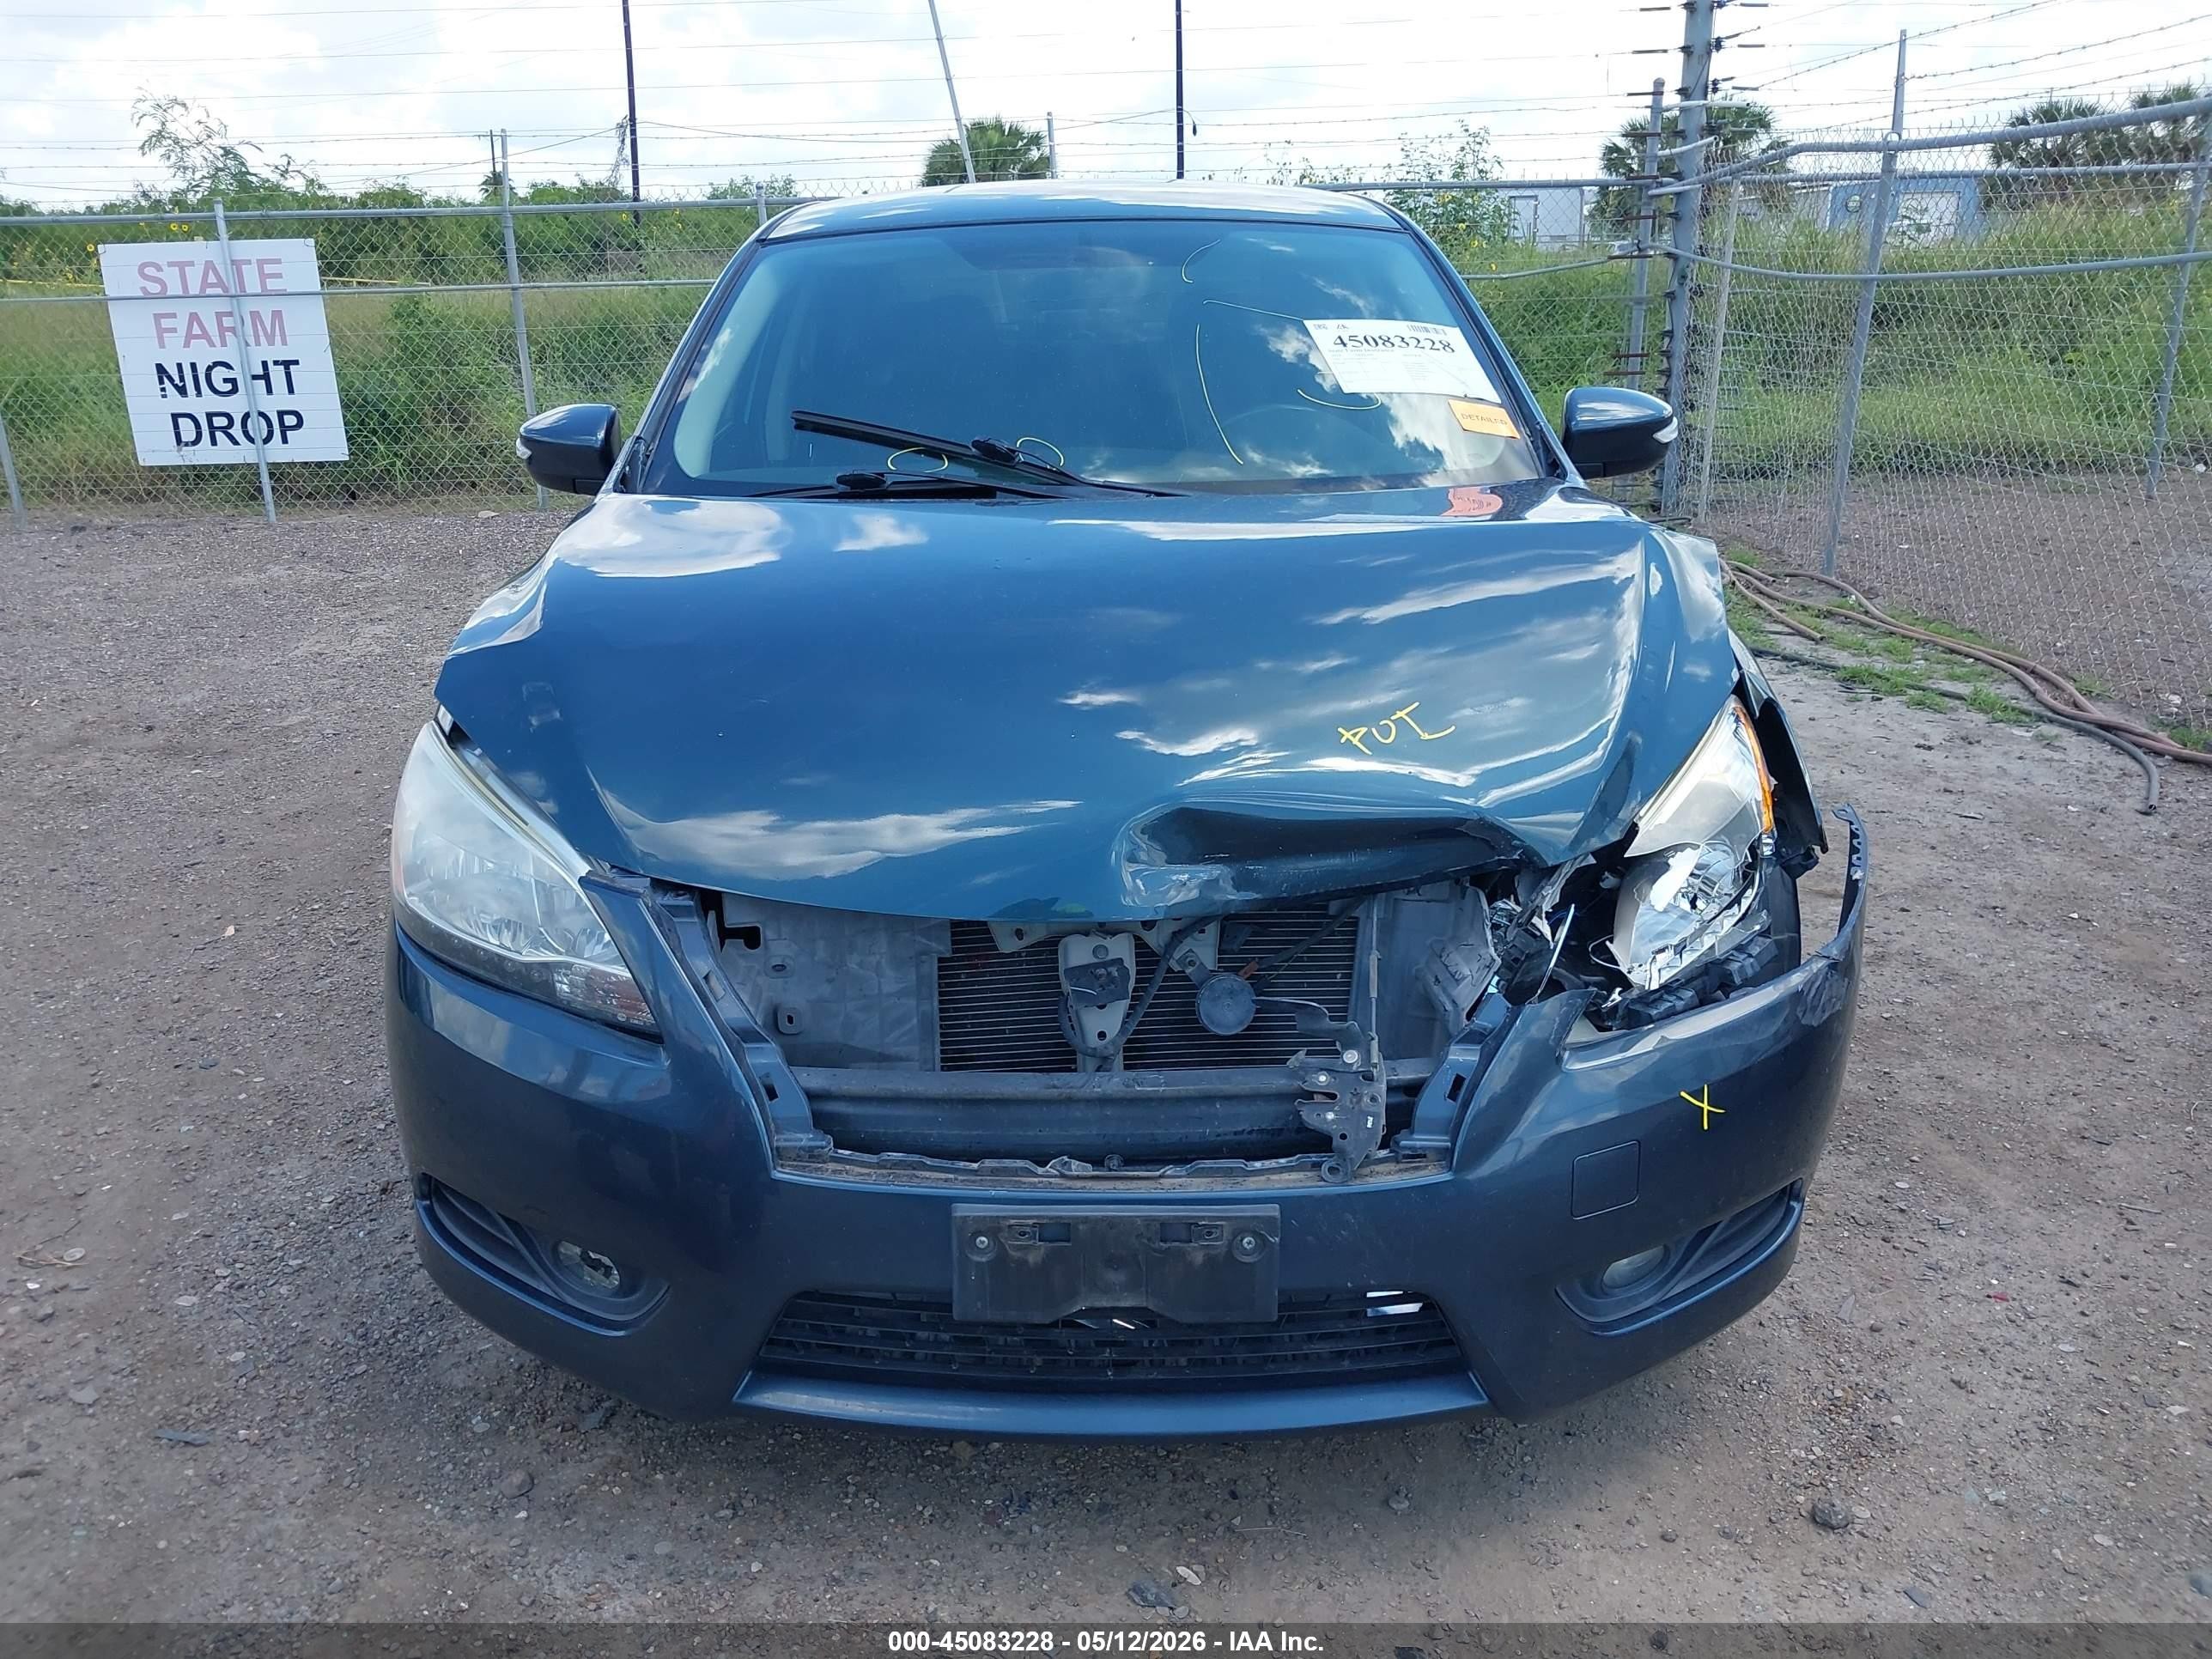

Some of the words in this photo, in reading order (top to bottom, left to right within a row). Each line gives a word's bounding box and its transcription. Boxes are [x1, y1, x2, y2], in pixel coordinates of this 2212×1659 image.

[137, 258, 288, 297] STATE
[152, 309, 289, 349] FARM
[1333, 334, 1455, 354] 45083228
[155, 358, 301, 399] NIGHT
[170, 409, 305, 448] DROP
[1461, 412, 1509, 426] DETAILED
